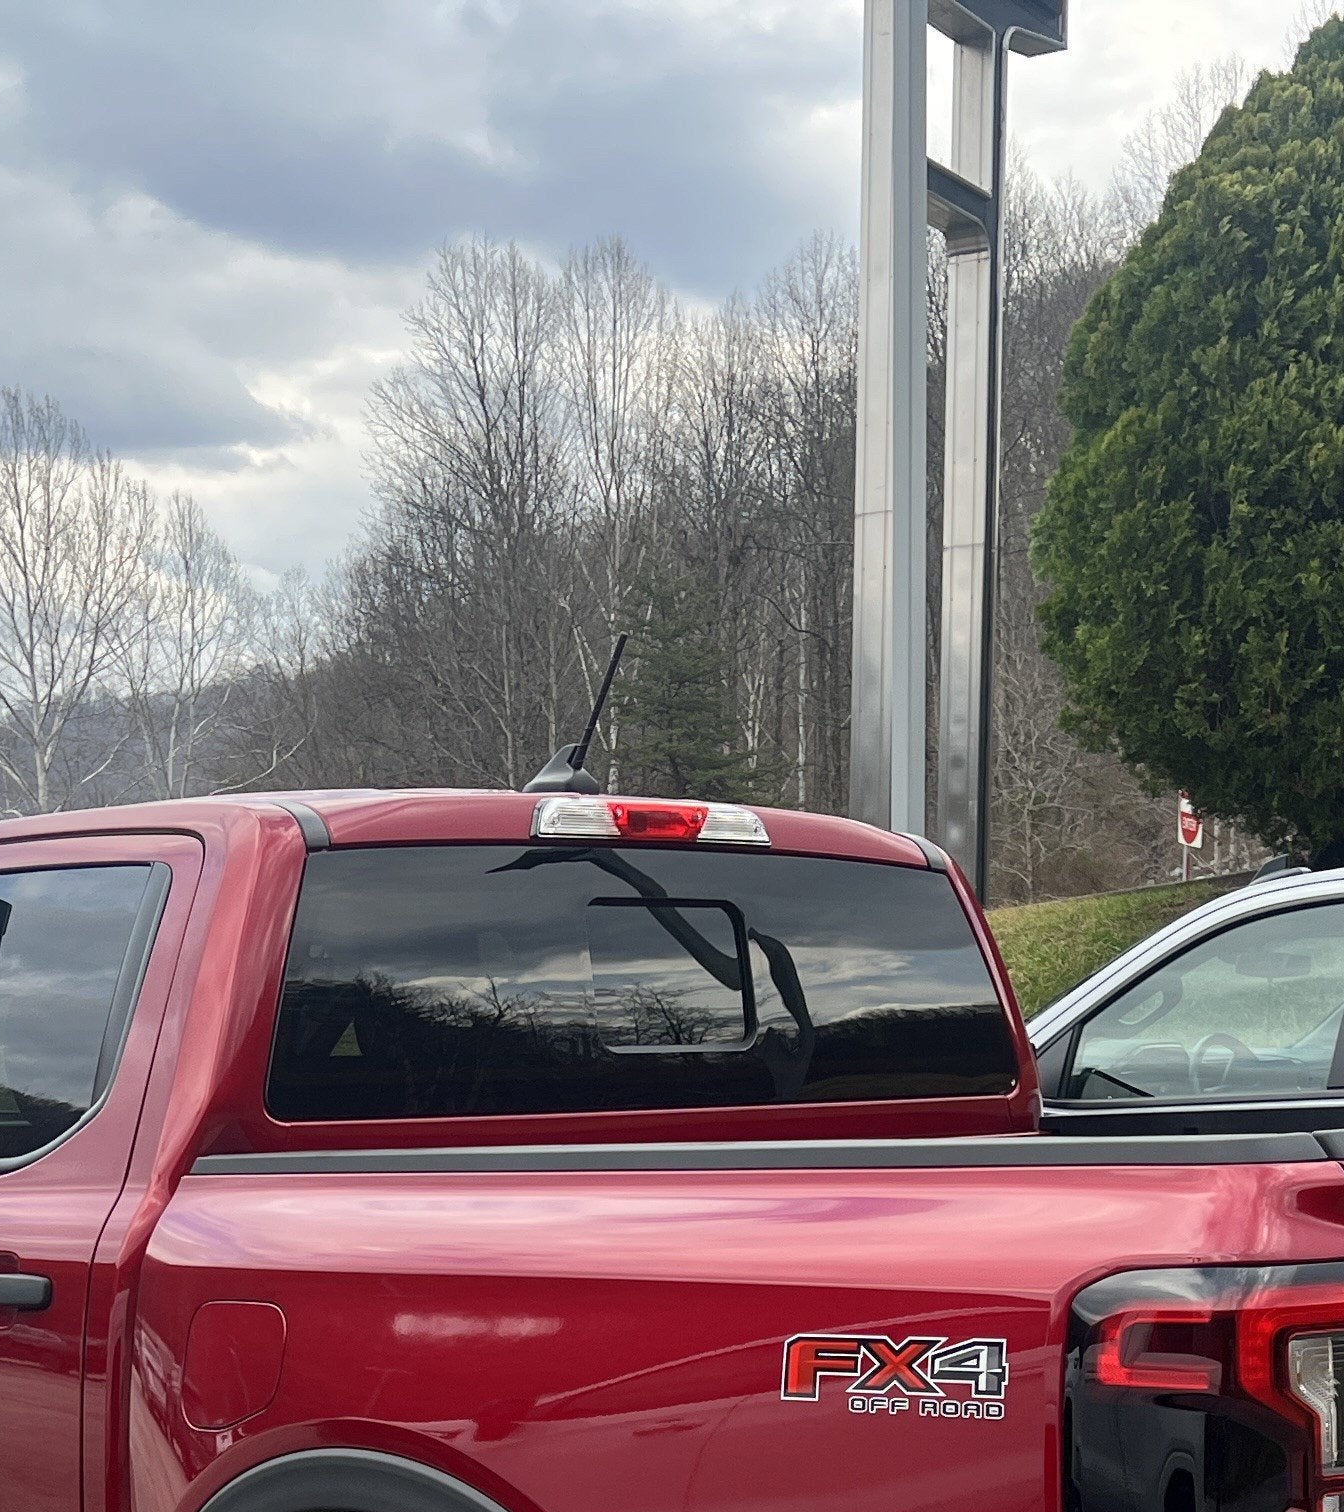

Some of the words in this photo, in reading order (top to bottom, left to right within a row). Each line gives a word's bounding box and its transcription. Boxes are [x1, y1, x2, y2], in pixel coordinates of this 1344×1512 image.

[781, 1333, 1009, 1401] FX4
[848, 1396, 909, 1415] OFF
[919, 1399, 1005, 1420] ROAD
